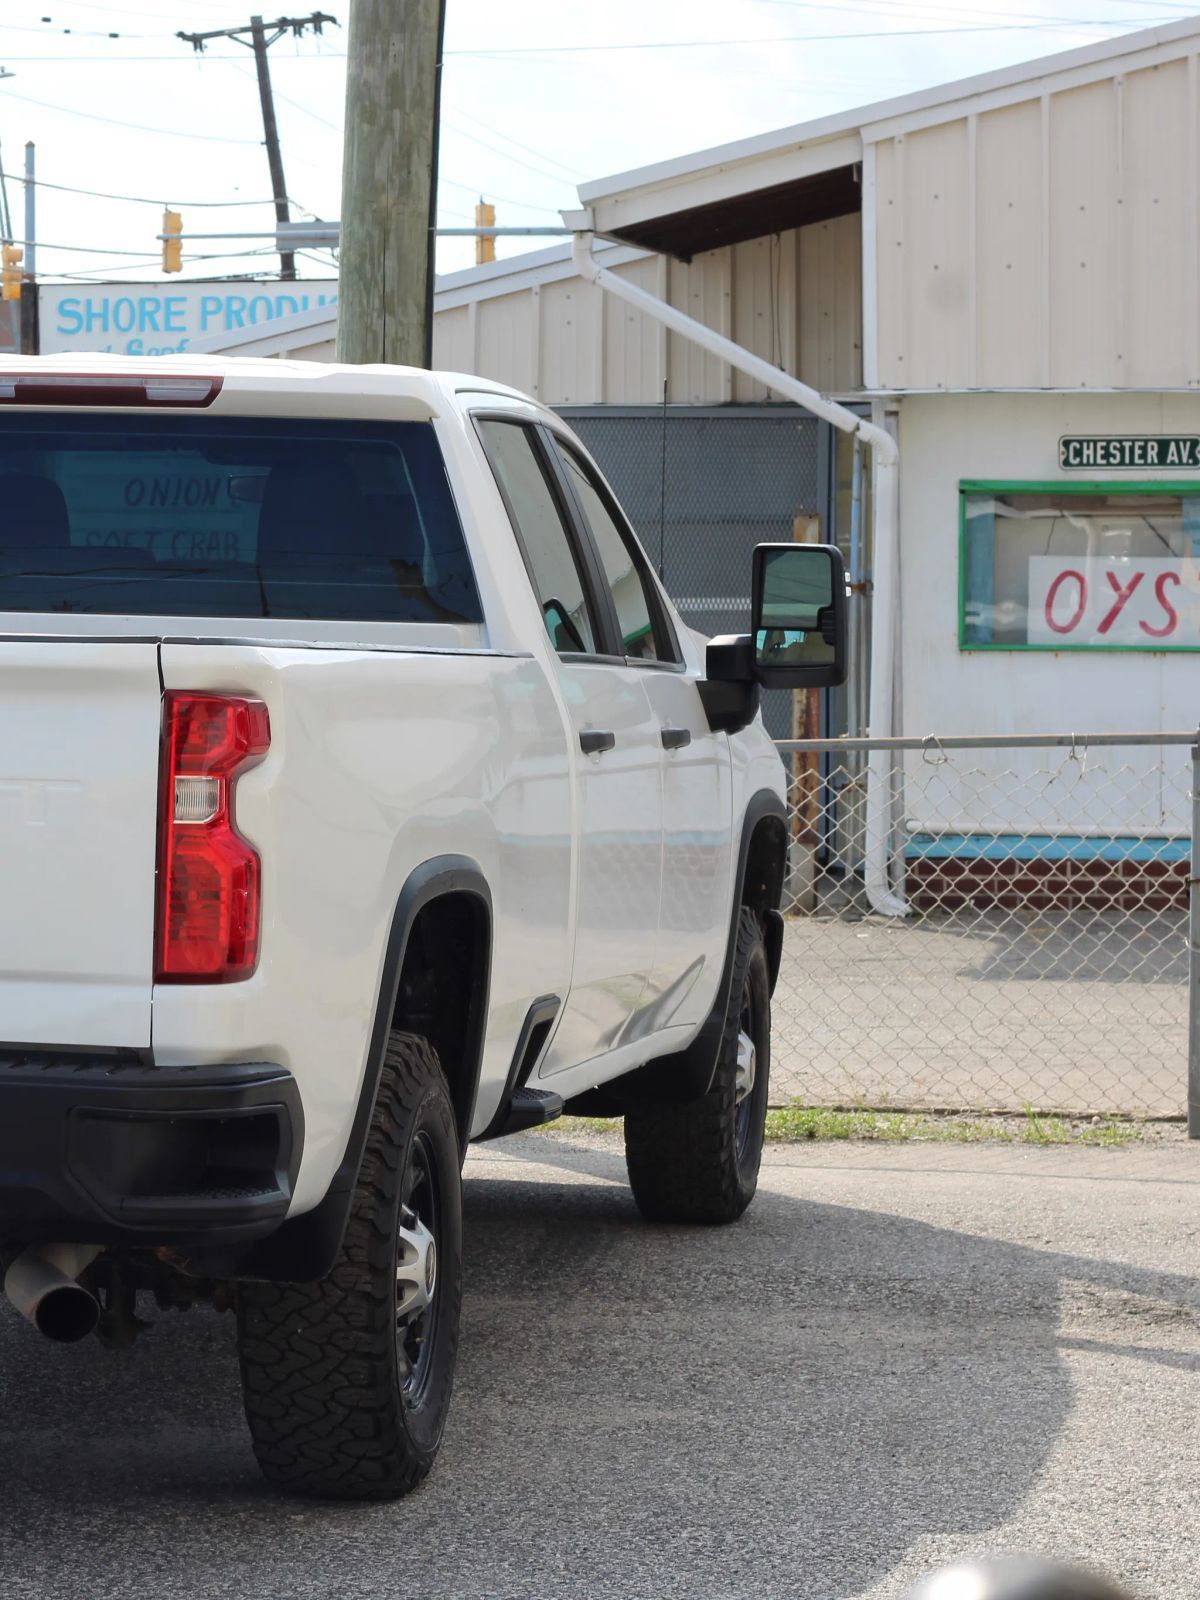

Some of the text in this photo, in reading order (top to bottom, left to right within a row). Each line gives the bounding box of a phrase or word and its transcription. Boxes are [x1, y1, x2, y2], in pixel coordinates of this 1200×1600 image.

[56, 293, 340, 335] SHORE PROD
[1068, 441, 1159, 466] CHESTER
[123, 477, 242, 509] ONION
[171, 530, 241, 561] CRAB
[1044, 568, 1200, 638] OYS
